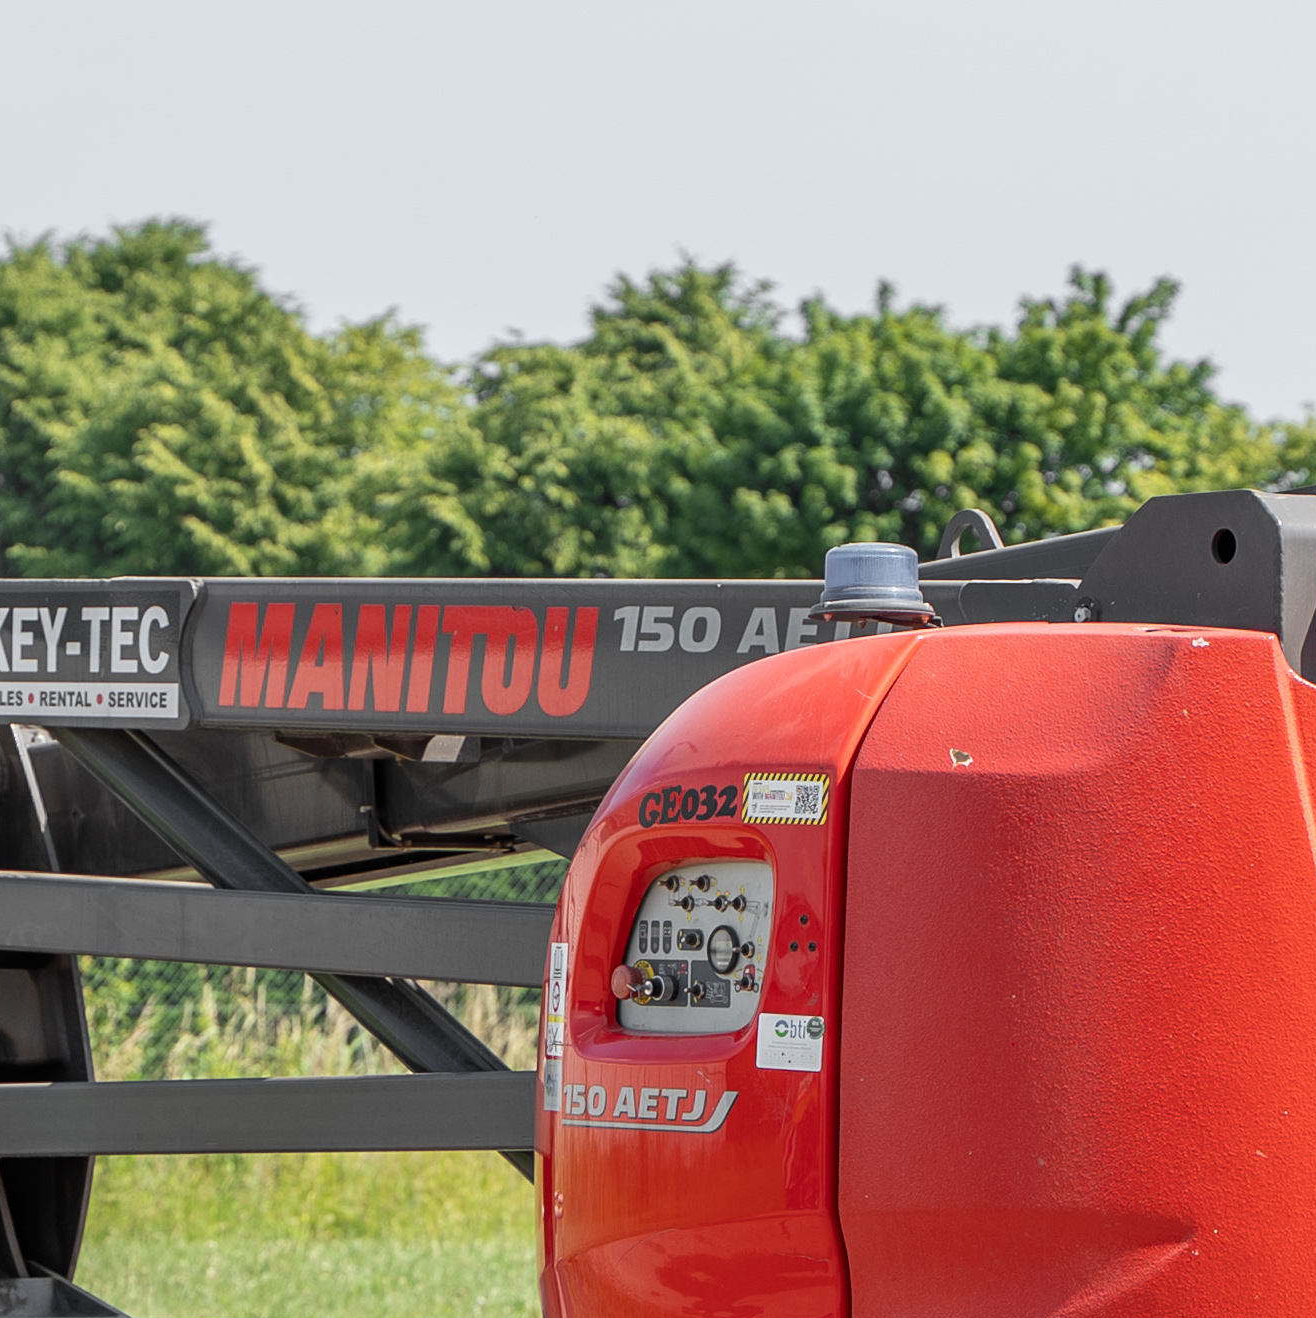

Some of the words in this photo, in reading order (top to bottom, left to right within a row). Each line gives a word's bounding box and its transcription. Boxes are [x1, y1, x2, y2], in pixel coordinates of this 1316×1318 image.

[613, 605, 721, 653] 150
[218, 602, 599, 717] MANITOU
[39, 691, 91, 708] RENTAL
[108, 691, 168, 709] SERVICE
[638, 784, 738, 829] GE032
[563, 1084, 607, 1117] 150
[612, 1086, 707, 1122] AETJ
